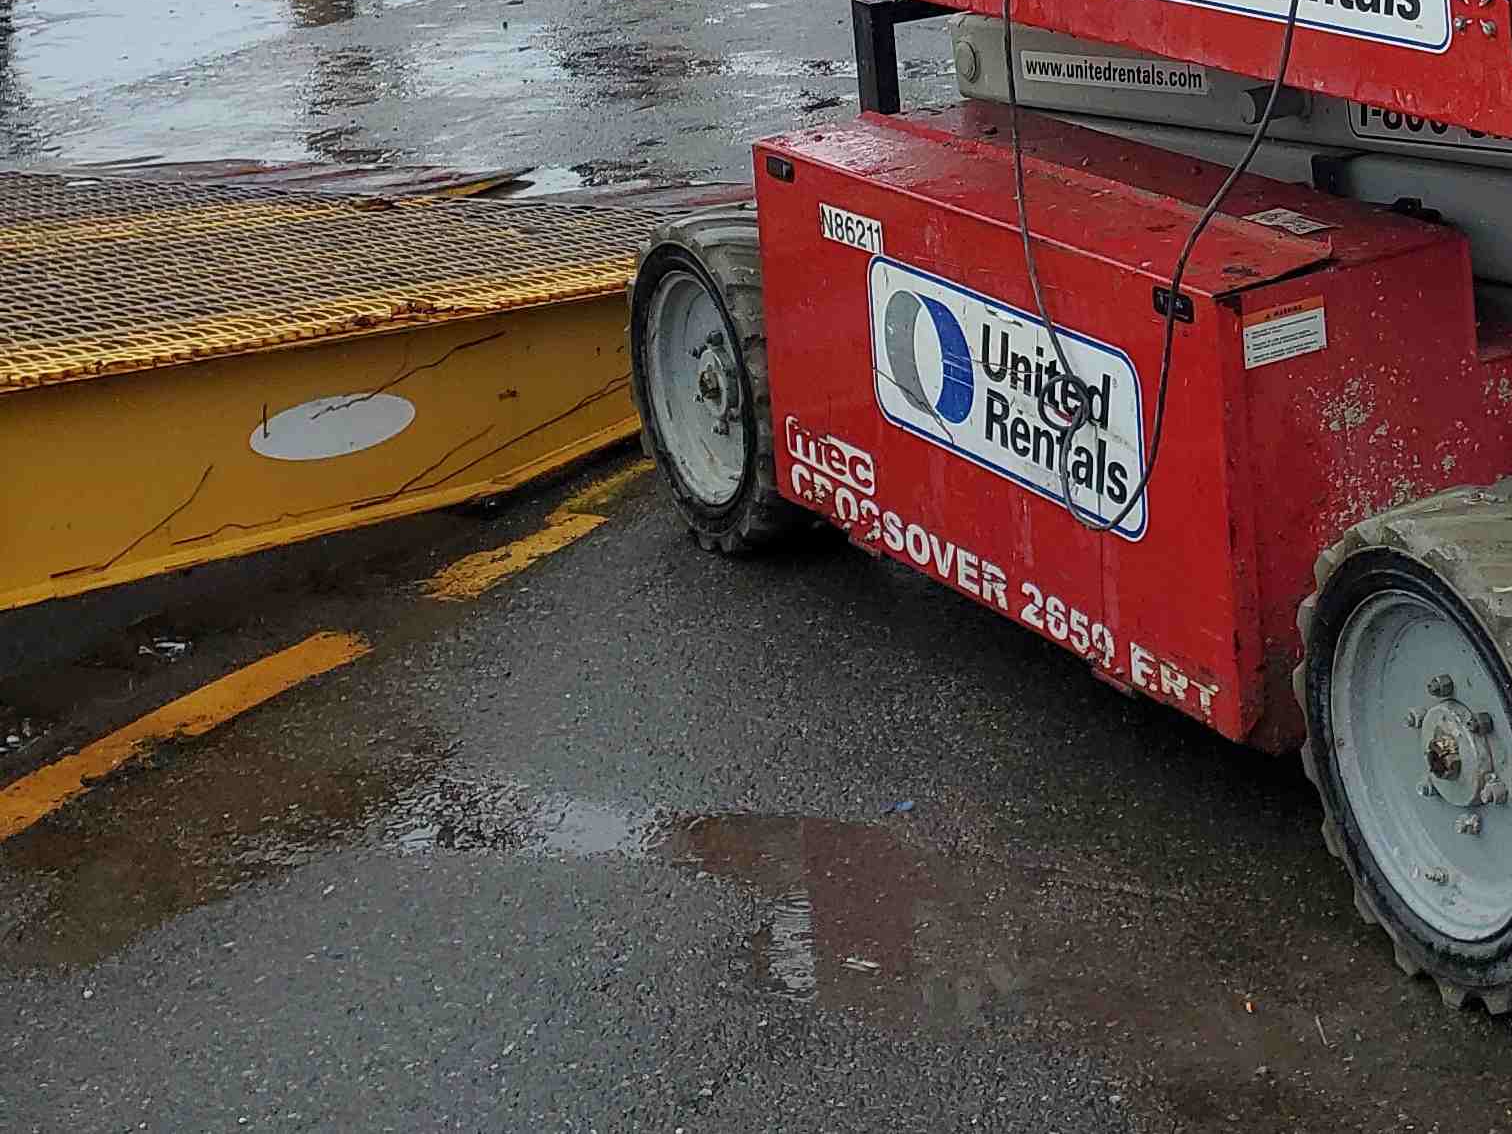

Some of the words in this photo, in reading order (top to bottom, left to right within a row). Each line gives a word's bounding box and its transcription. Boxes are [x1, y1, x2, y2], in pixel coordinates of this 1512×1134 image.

[1025, 59, 1203, 89] www.unitedrentals.com
[820, 205, 882, 254] N86211
[981, 322, 1112, 431] United
